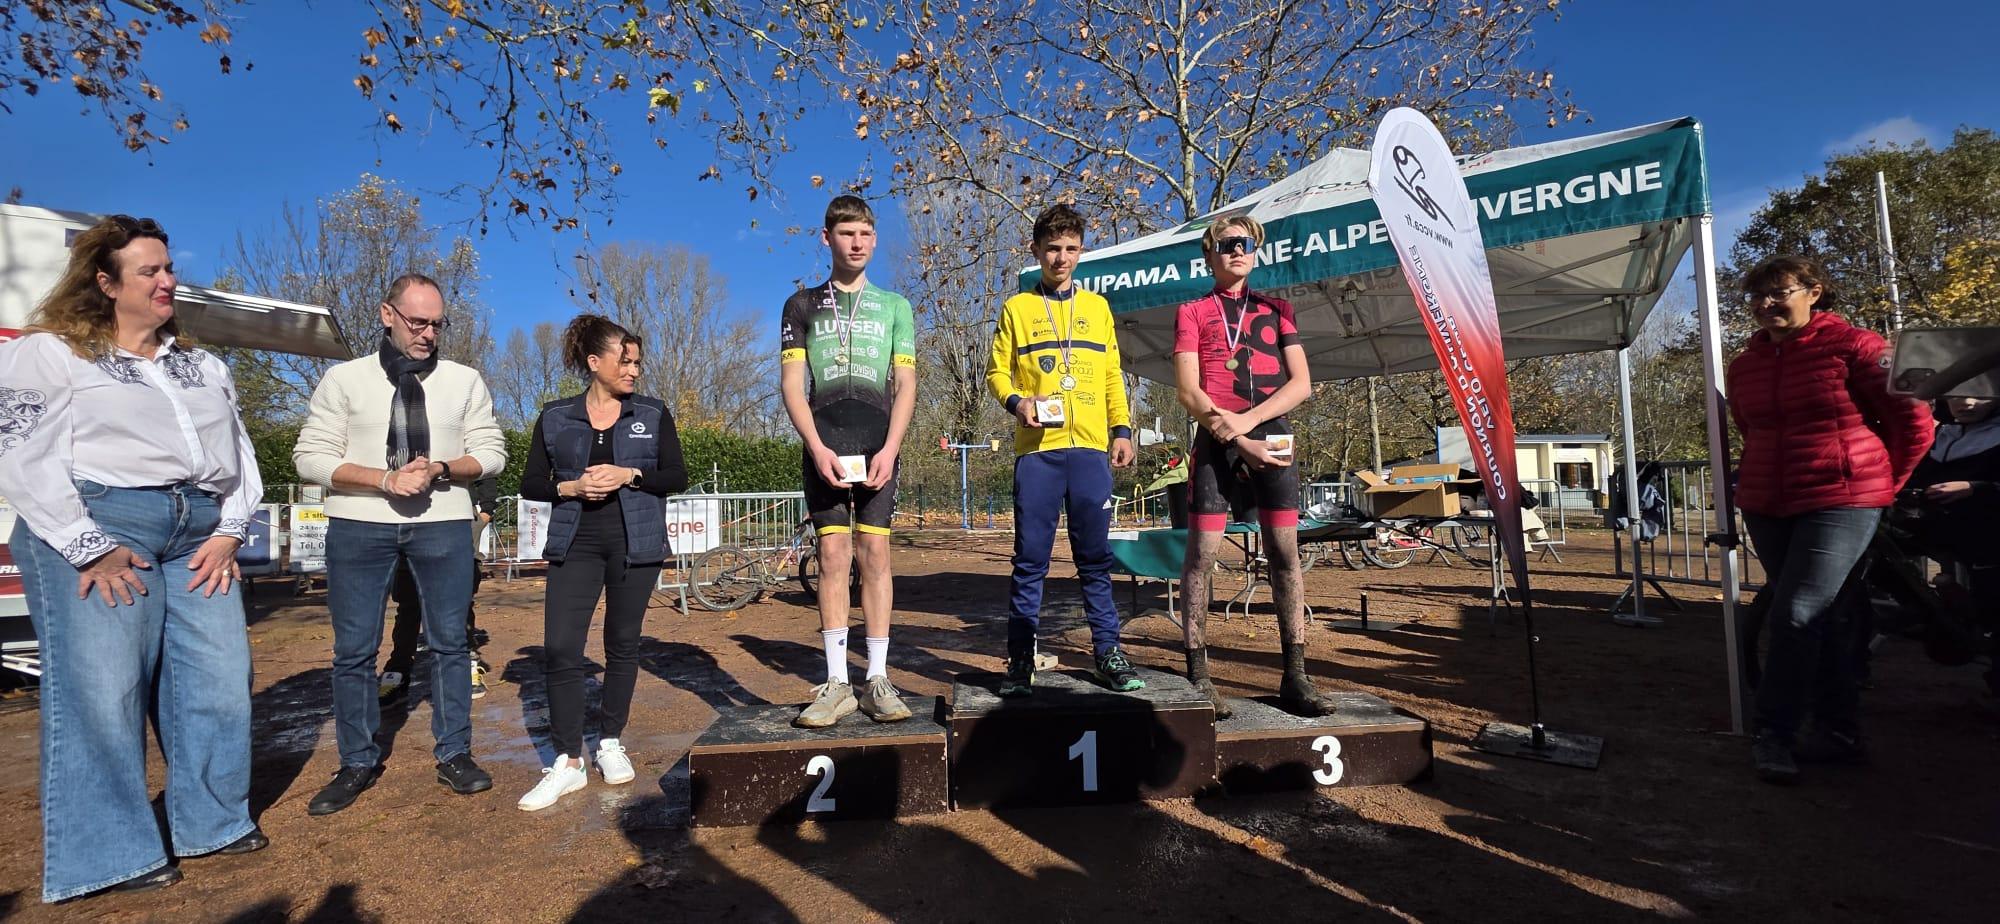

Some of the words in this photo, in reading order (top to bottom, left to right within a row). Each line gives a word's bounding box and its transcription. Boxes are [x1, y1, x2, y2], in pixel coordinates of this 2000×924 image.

[806, 755, 836, 813] 2
[1069, 730, 1099, 792] 1
[1311, 735, 1345, 787] 3
